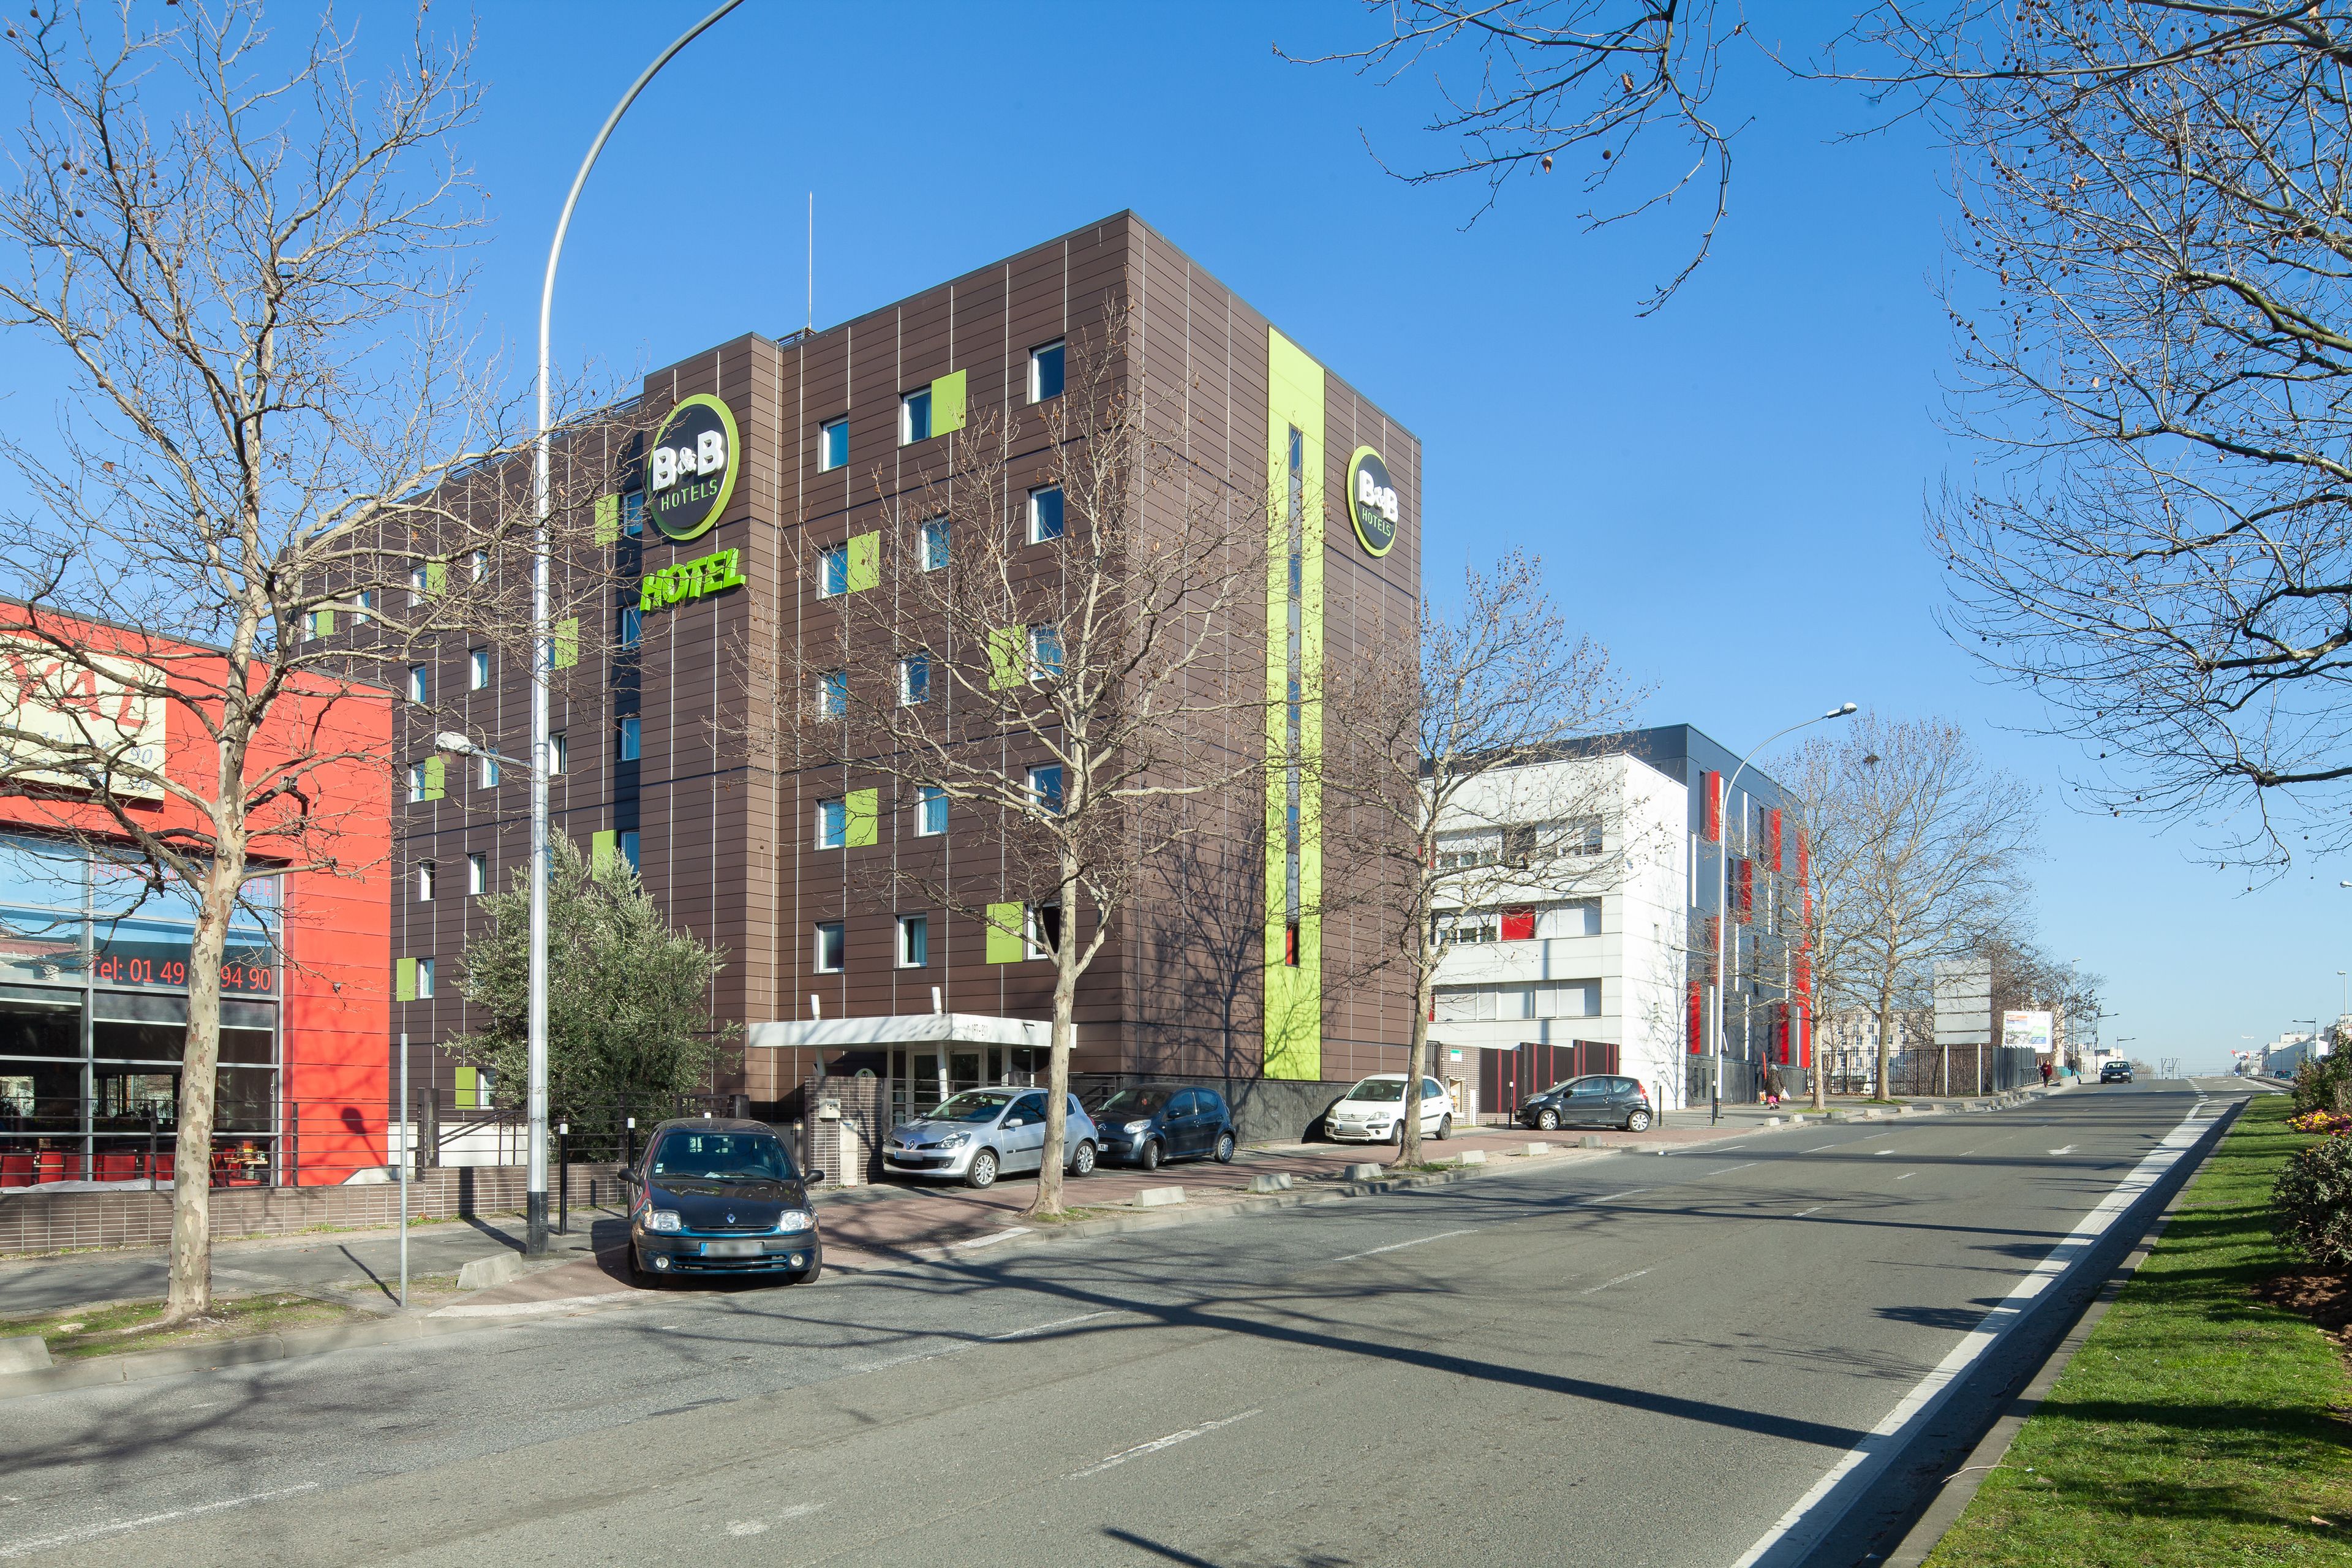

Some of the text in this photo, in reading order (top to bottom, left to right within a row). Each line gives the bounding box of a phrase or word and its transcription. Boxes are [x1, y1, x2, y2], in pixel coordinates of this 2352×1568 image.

[653, 430, 724, 491] B&B
[661, 479, 718, 512] HOTELS
[1359, 470, 1399, 523] B&B
[1362, 507, 1391, 537] HOTELS
[639, 548, 747, 611] HOTEL
[130, 959, 154, 982] 01
[160, 962, 185, 985] 49
[221, 965, 243, 989] 94
[249, 968, 271, 990] 90
